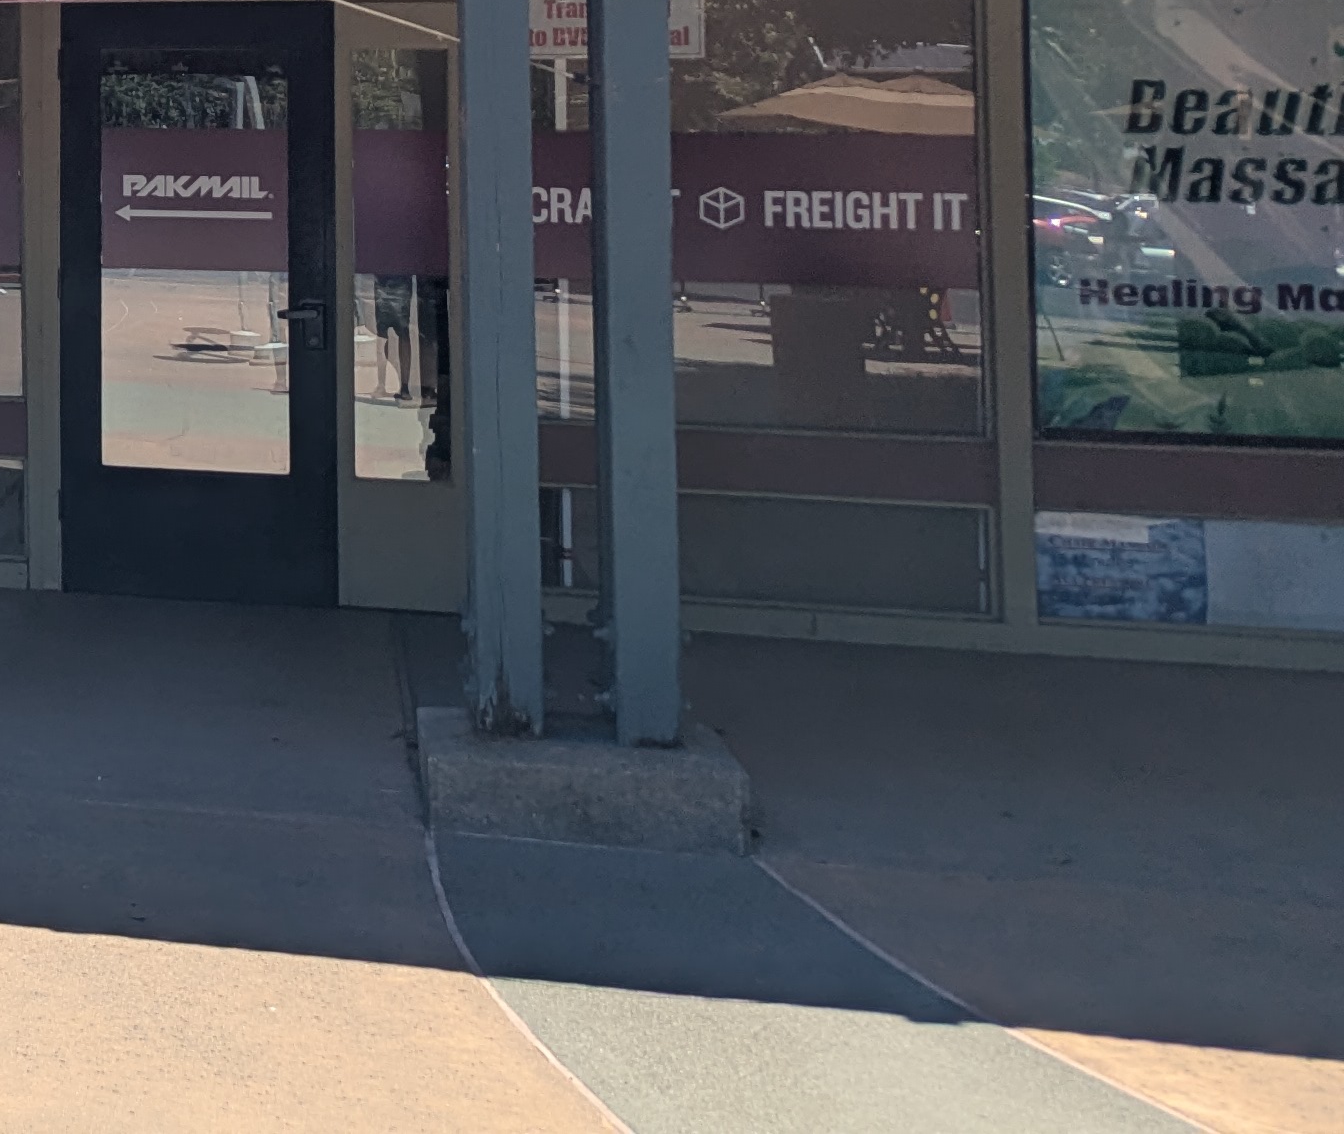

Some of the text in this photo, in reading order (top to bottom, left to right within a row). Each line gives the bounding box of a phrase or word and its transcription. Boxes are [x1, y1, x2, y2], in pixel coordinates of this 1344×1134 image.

[123, 174, 269, 199] PAKMAIL
[1130, 144, 1344, 205] Massa
[531, 186, 593, 224] CRA
[764, 190, 968, 232] FREIGHT IT
[1079, 278, 1344, 315] Healing Ma
